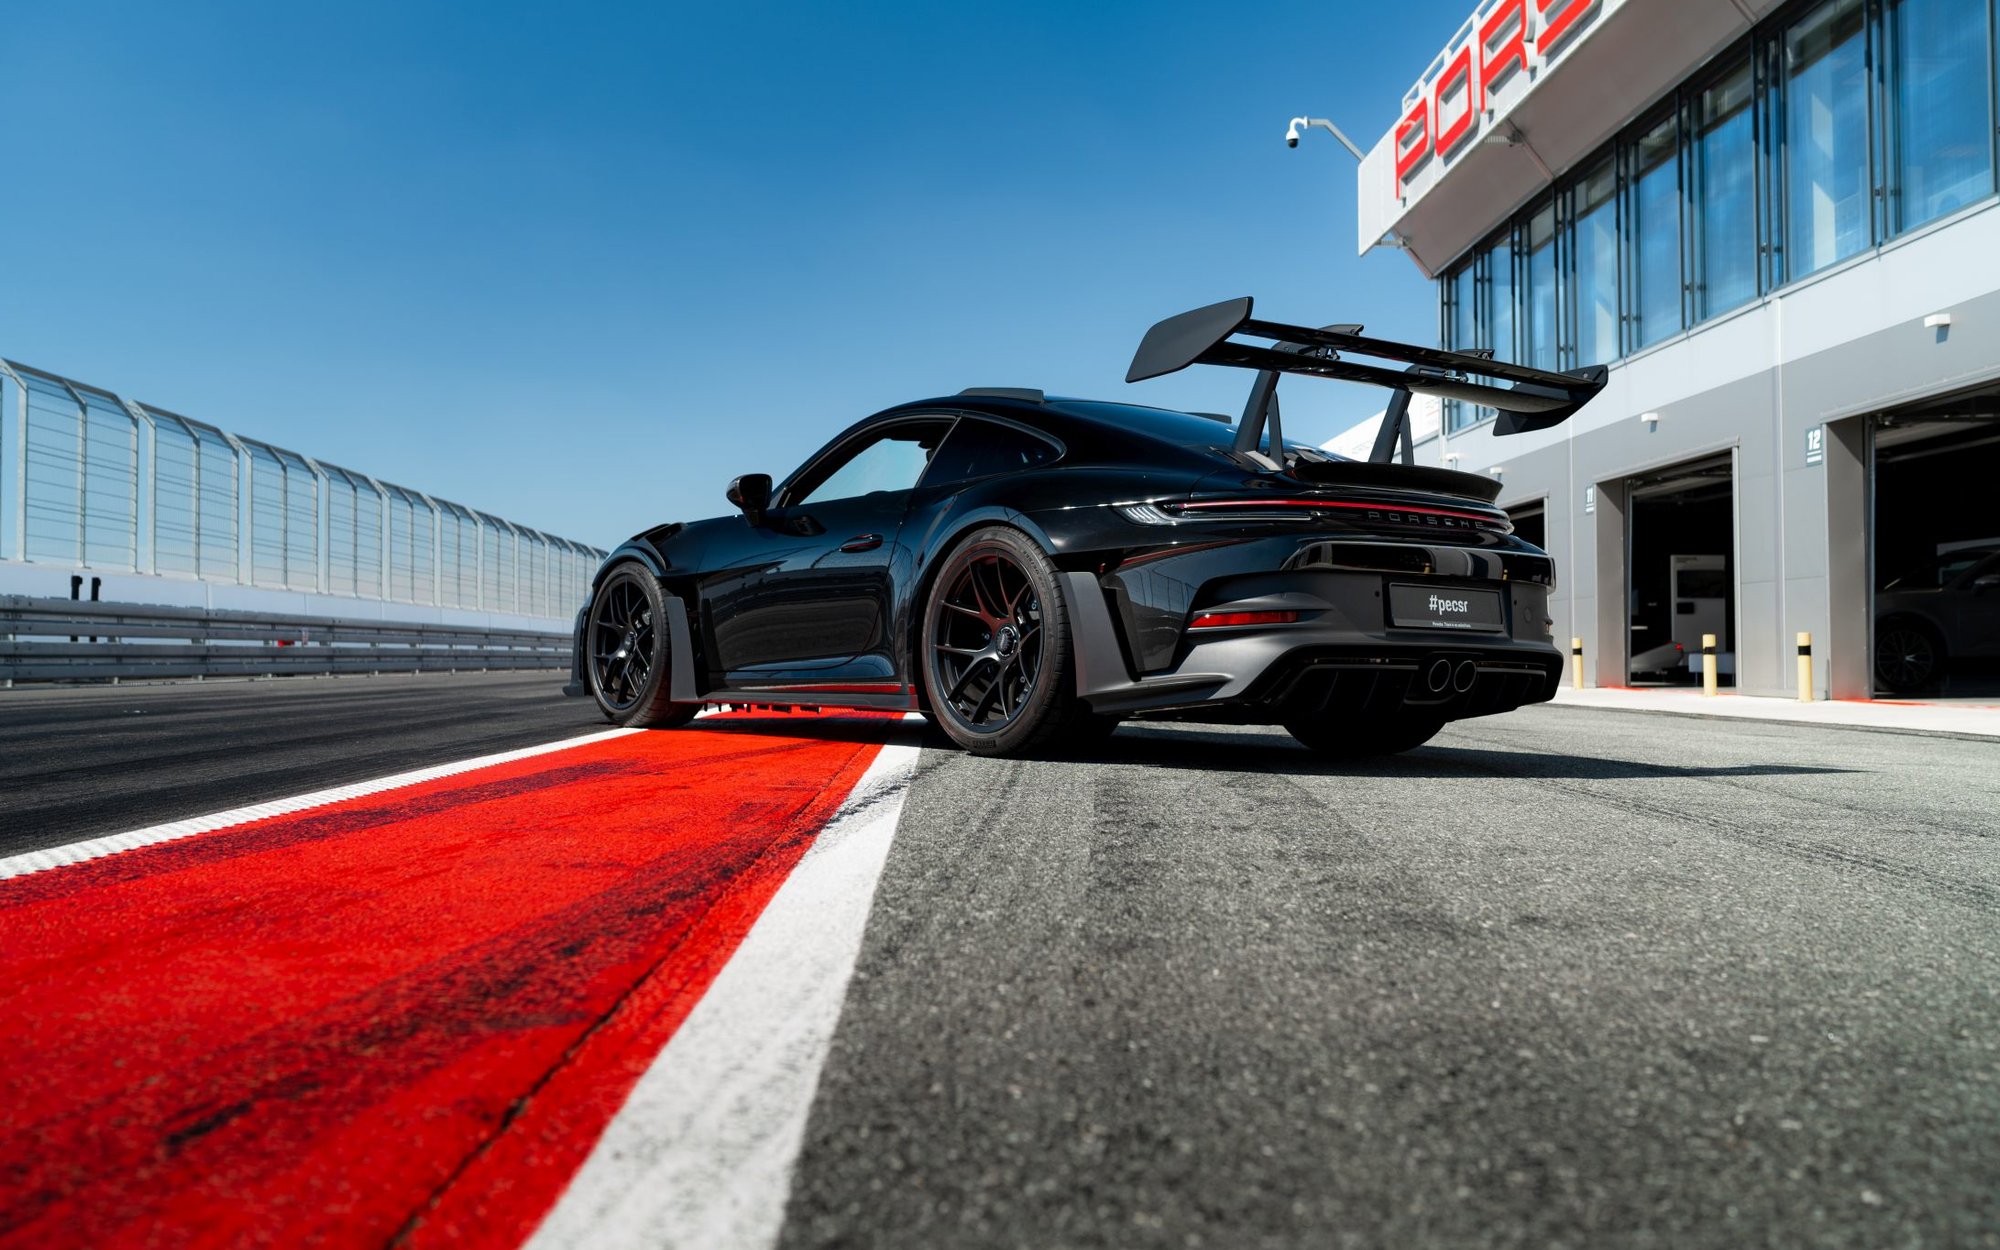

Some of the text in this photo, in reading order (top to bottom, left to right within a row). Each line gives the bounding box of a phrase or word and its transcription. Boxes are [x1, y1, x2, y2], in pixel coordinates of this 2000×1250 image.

[1808, 429, 1821, 450] 12
[1587, 488, 1593, 503] 11
[1367, 511, 1485, 529] PORSCHE
[1429, 594, 1468, 615] #pecsr
